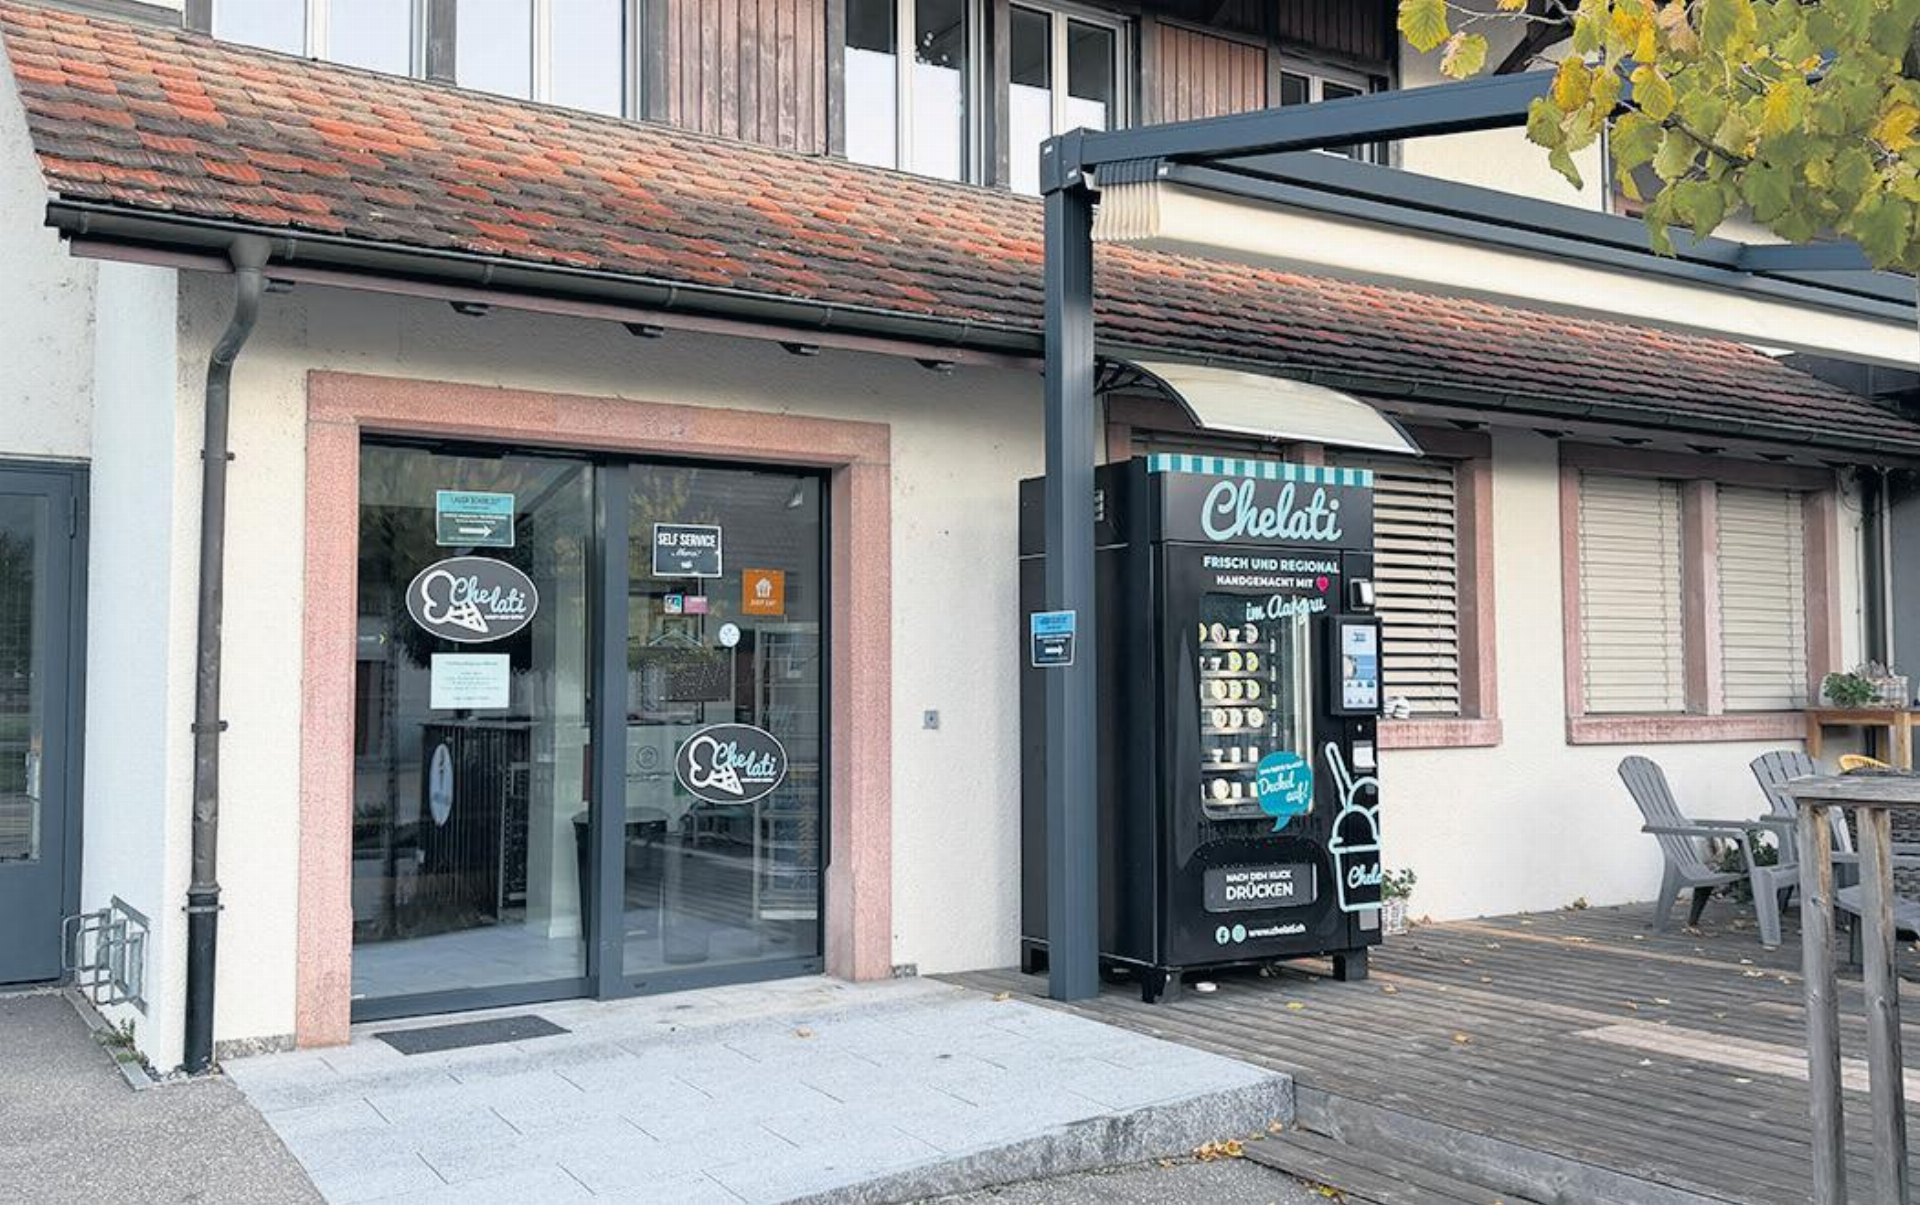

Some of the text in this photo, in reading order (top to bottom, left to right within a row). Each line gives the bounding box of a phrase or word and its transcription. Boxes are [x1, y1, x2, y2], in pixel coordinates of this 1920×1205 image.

[1201, 478, 1342, 541] Chelati
[657, 533, 717, 548] SELF SERVICE
[1203, 555, 1340, 574] FRISCH UND REGIONAL
[1216, 575, 1314, 588] HANDGEMACHT MIT
[449, 575, 527, 613] Chelati
[1246, 594, 1327, 624] im Aargau
[712, 741, 777, 777] Chelati
[1226, 873, 1249, 883] NACH
[1225, 881, 1294, 901] DRÜCKEN
